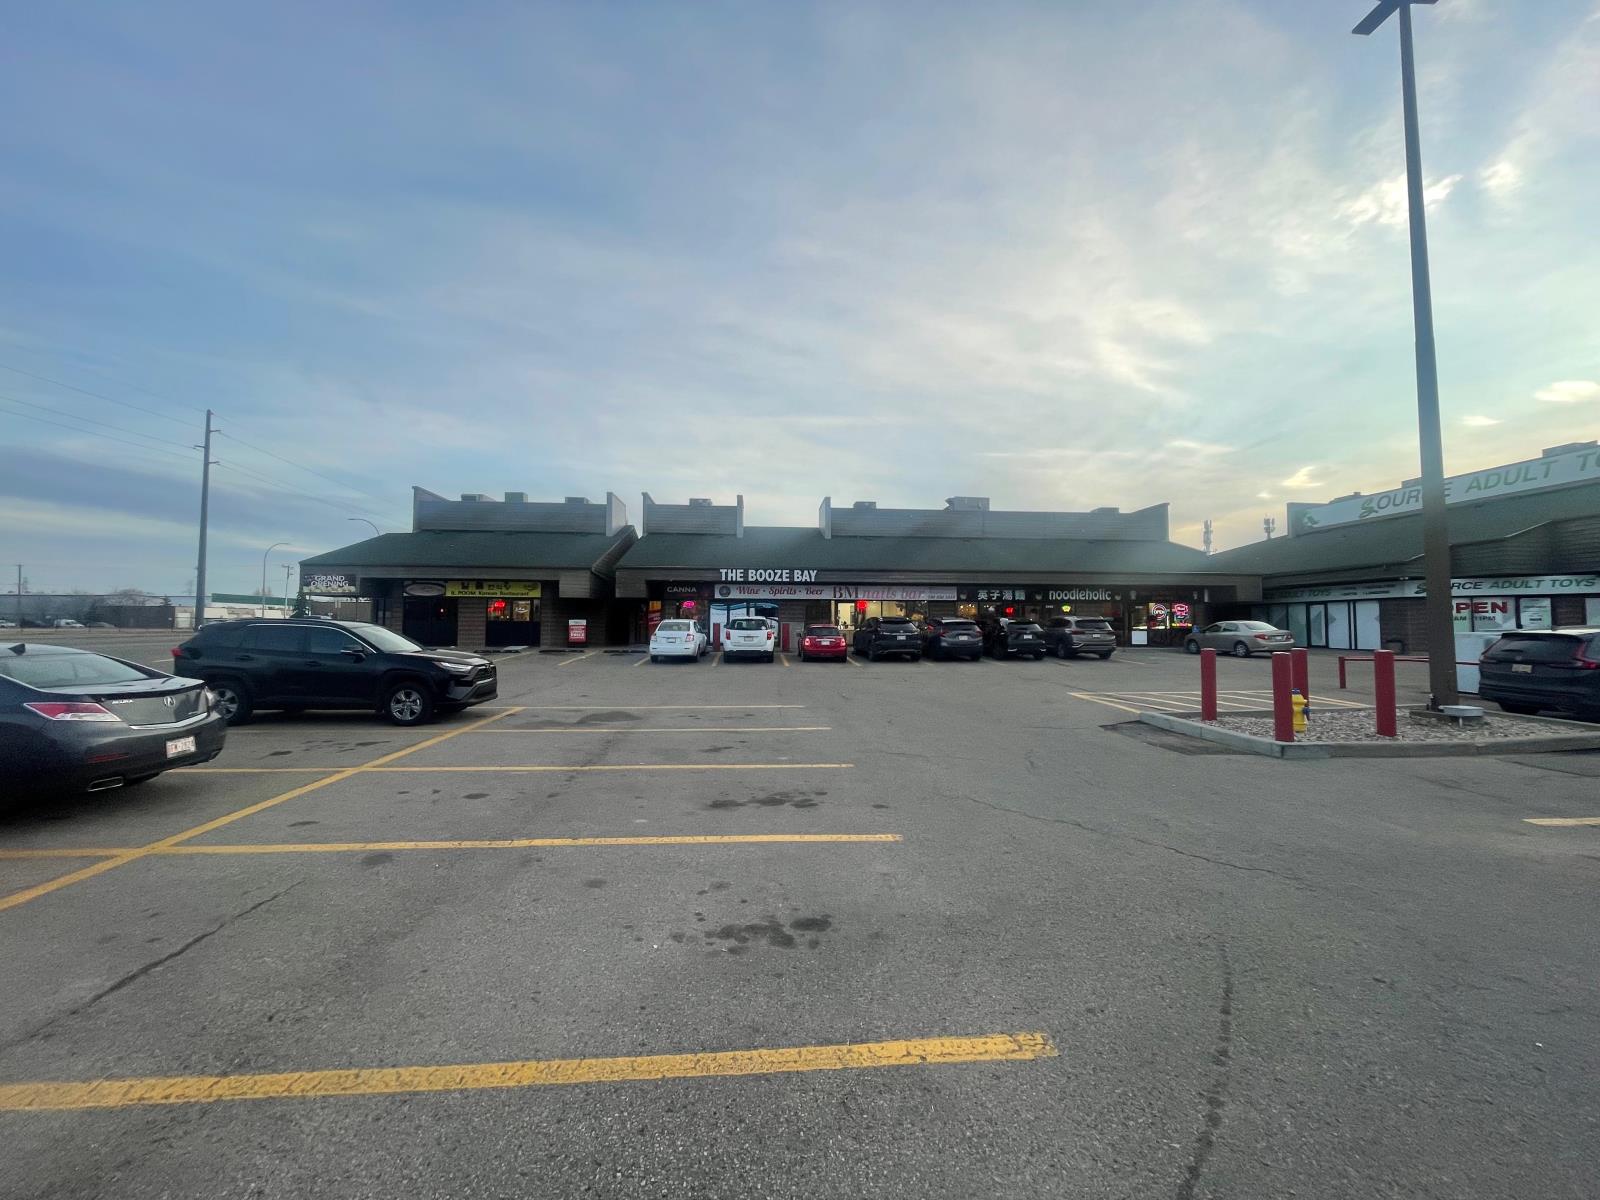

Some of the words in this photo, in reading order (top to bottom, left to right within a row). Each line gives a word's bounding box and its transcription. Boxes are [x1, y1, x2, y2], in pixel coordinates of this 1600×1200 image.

[1359, 481, 1452, 518] SOURE
[1465, 459, 1558, 493] ADULT
[719, 569, 744, 581] THE
[748, 569, 790, 582] BOOZE
[794, 570, 818, 582] BAY
[1490, 580, 1545, 589] ADULT
[1547, 578, 1597, 588] TOYS
[735, 586, 761, 595] Wine
[768, 586, 797, 597] Spirits
[804, 586, 825, 596] Beer
[833, 586, 859, 599] BM
[1049, 588, 1112, 601] noodleholic
[1455, 602, 1508, 614] PEN
